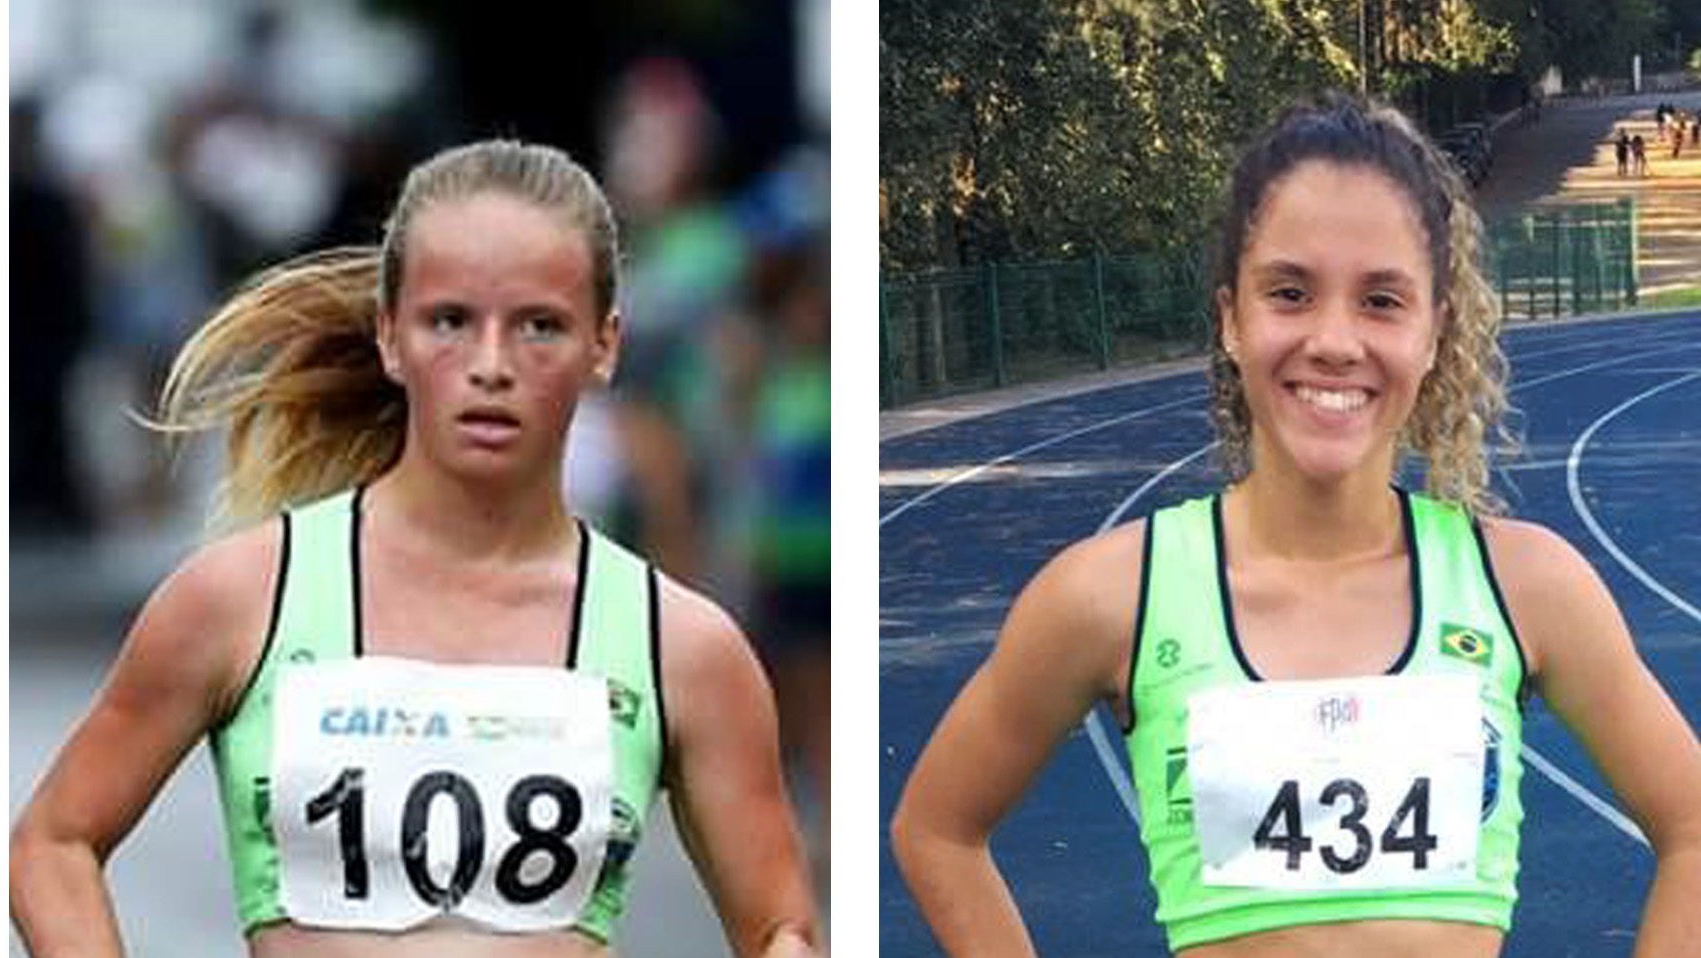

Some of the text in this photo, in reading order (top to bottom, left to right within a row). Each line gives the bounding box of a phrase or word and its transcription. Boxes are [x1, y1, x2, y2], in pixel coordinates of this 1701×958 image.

[320, 708, 449, 737] CAIXA
[305, 767, 582, 911] 108
[1252, 776, 1438, 874] 434
